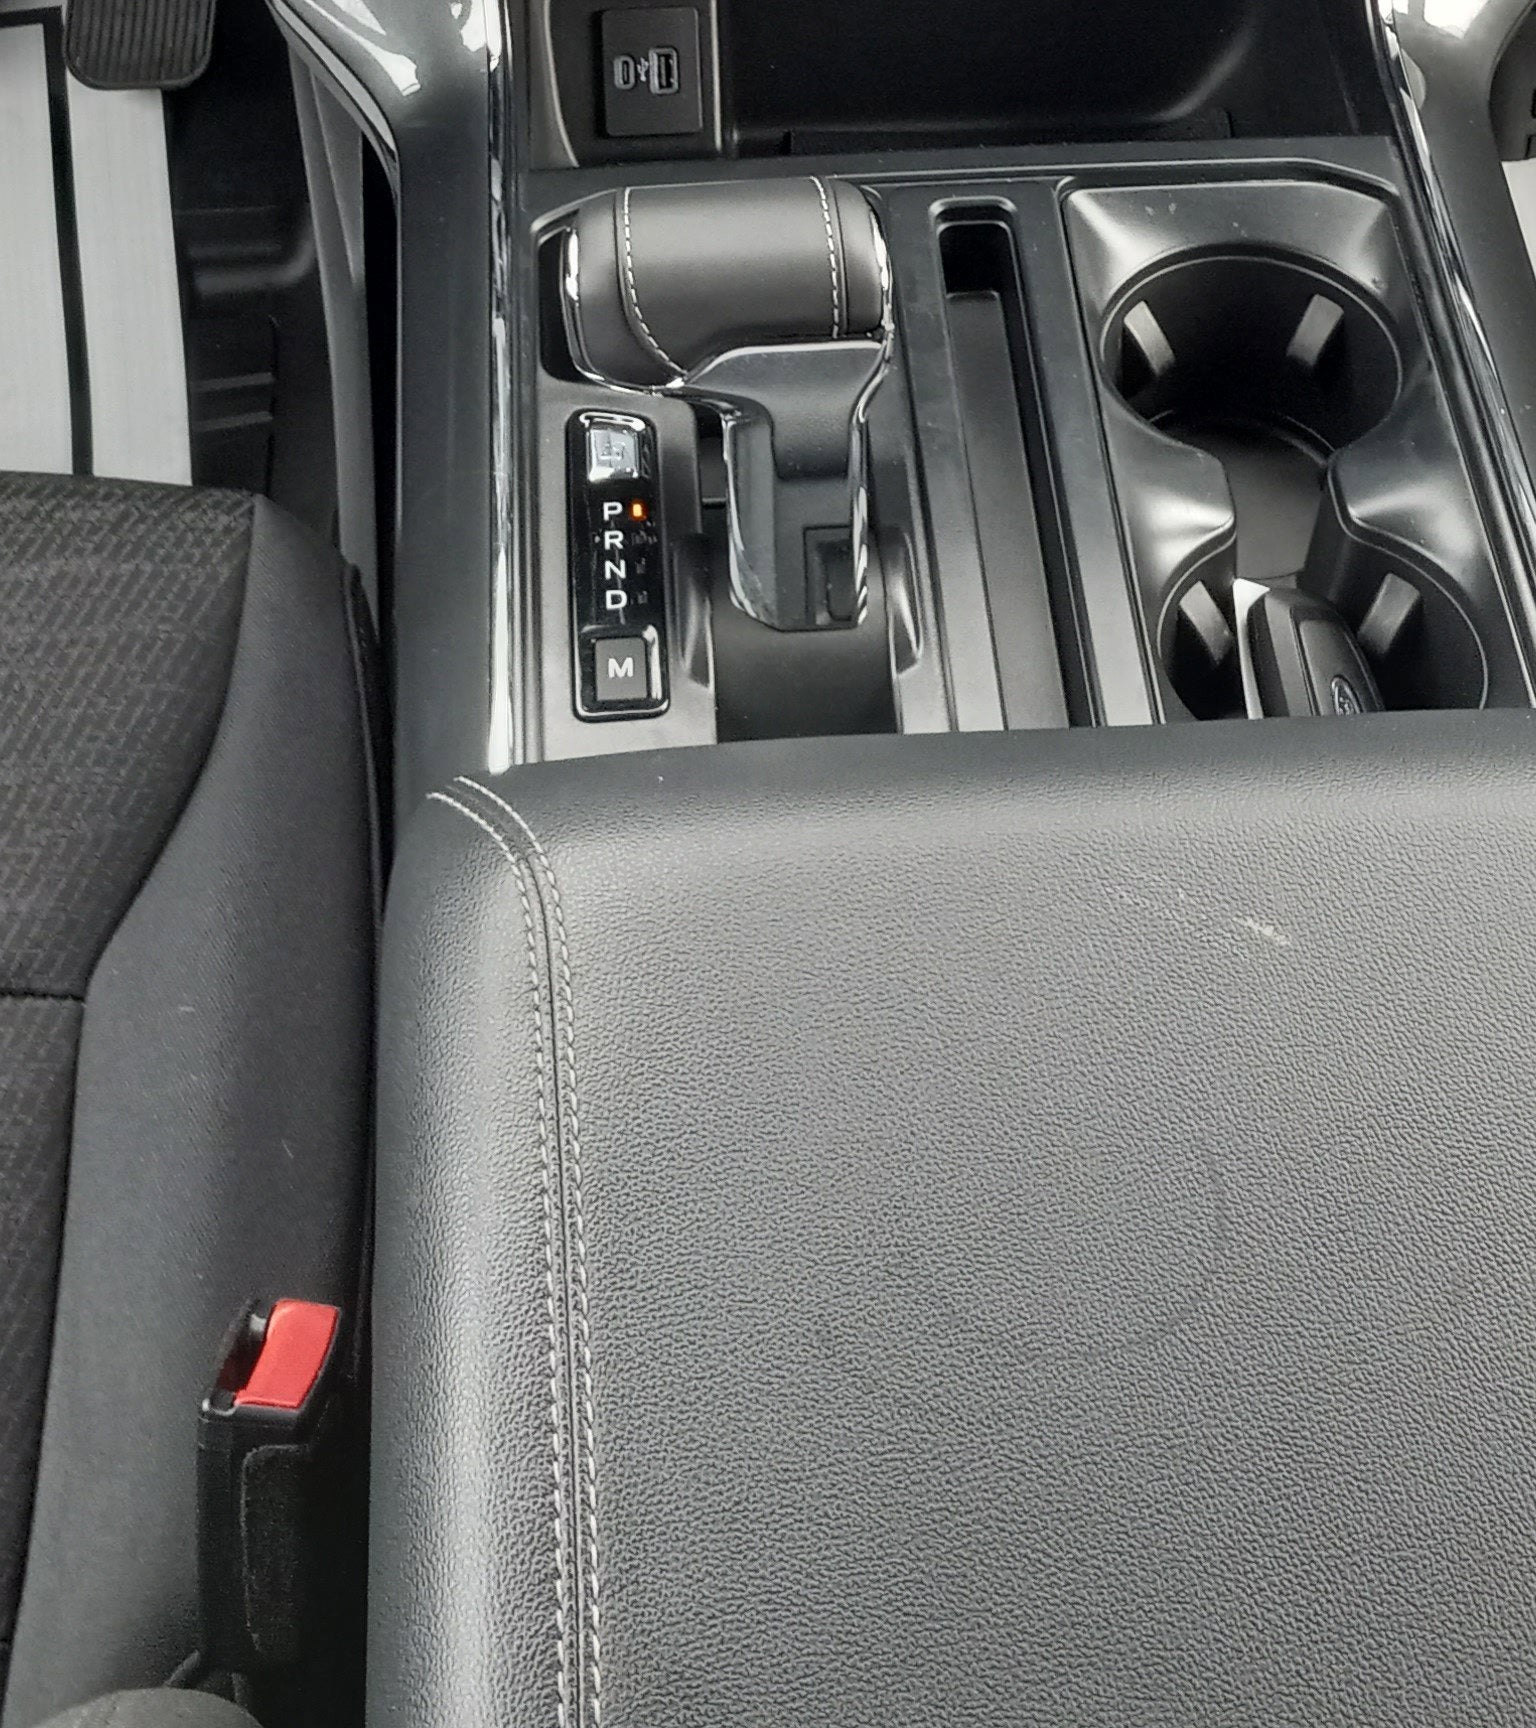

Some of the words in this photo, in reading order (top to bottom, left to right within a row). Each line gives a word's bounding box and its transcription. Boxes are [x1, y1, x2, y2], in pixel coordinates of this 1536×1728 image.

[603, 502, 623, 521] P
[604, 530, 624, 551] R
[604, 560, 626, 580] N
[606, 589, 628, 610] D
[607, 656, 634, 679] M
